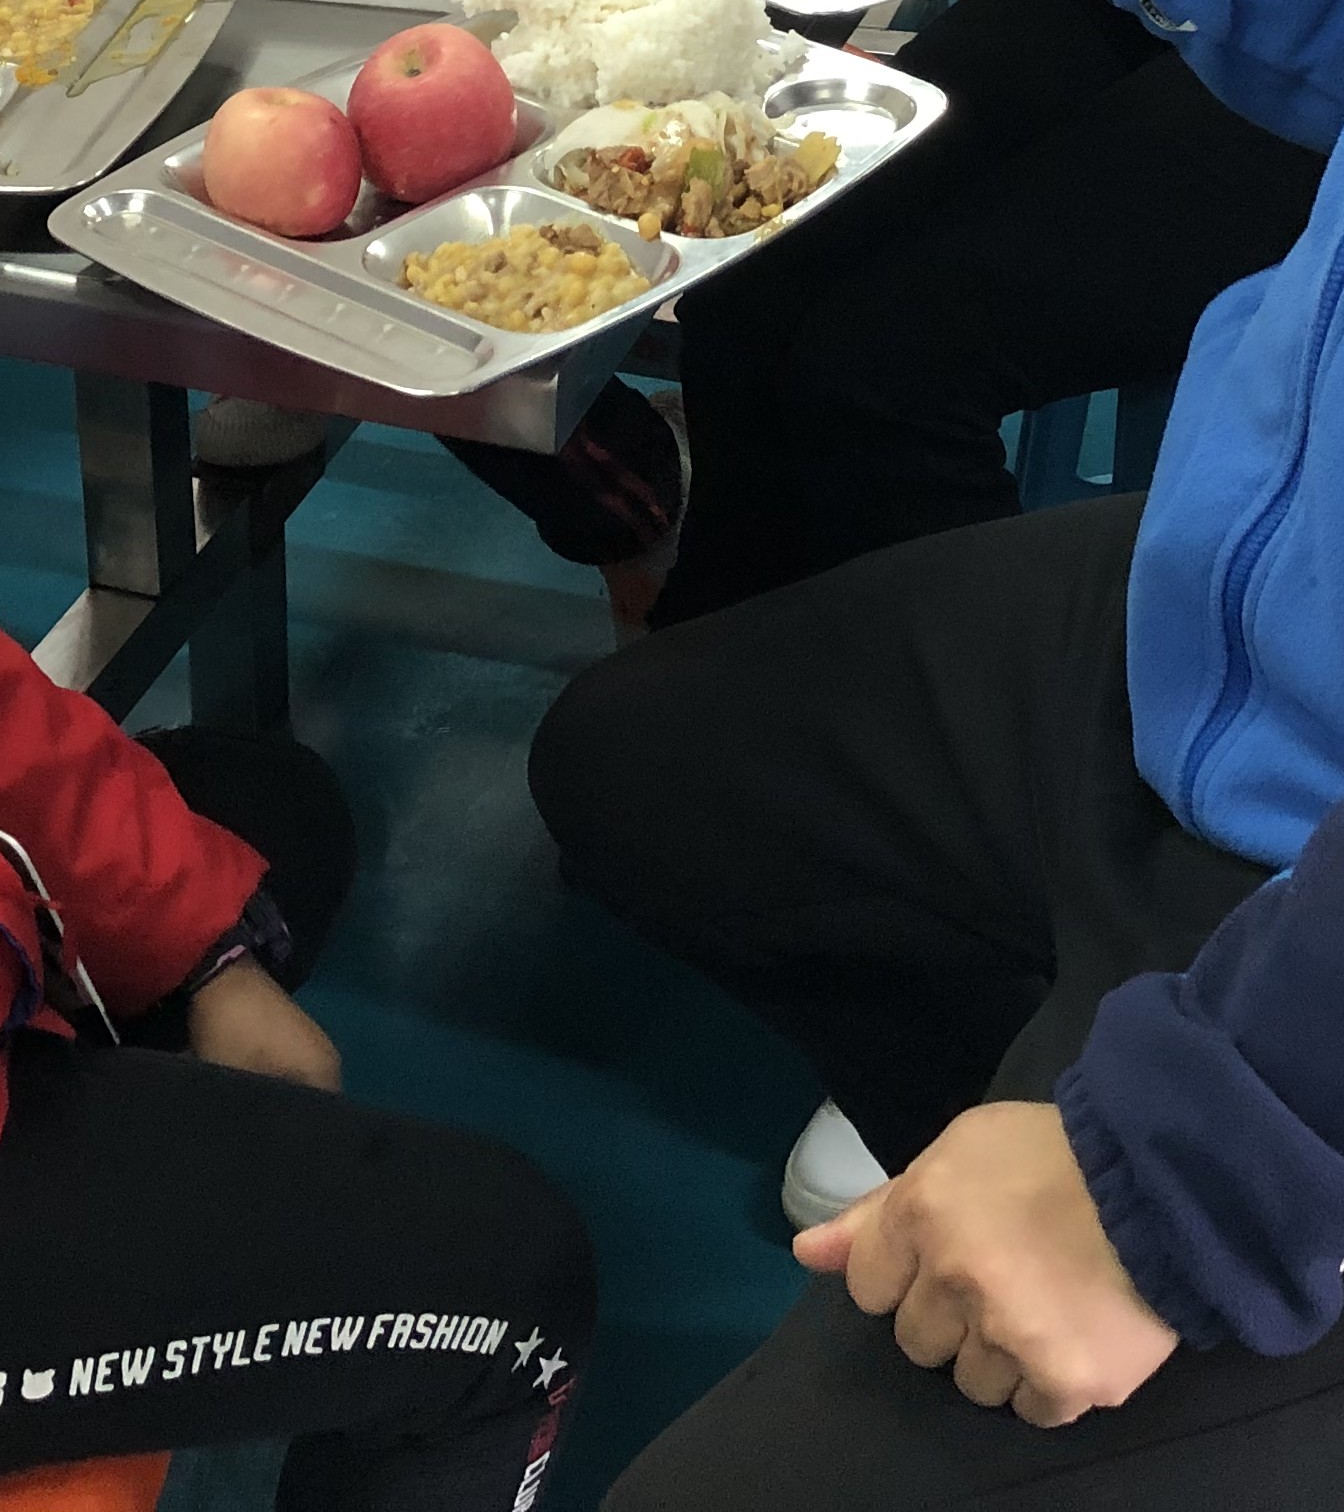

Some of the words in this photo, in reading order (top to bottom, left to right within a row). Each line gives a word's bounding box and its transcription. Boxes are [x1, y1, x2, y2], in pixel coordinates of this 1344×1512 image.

[68, 1346, 155, 1397] NEW
[162, 1323, 280, 1380] STYLE
[280, 1316, 363, 1357] NEW
[366, 1313, 510, 1356] FASHION
